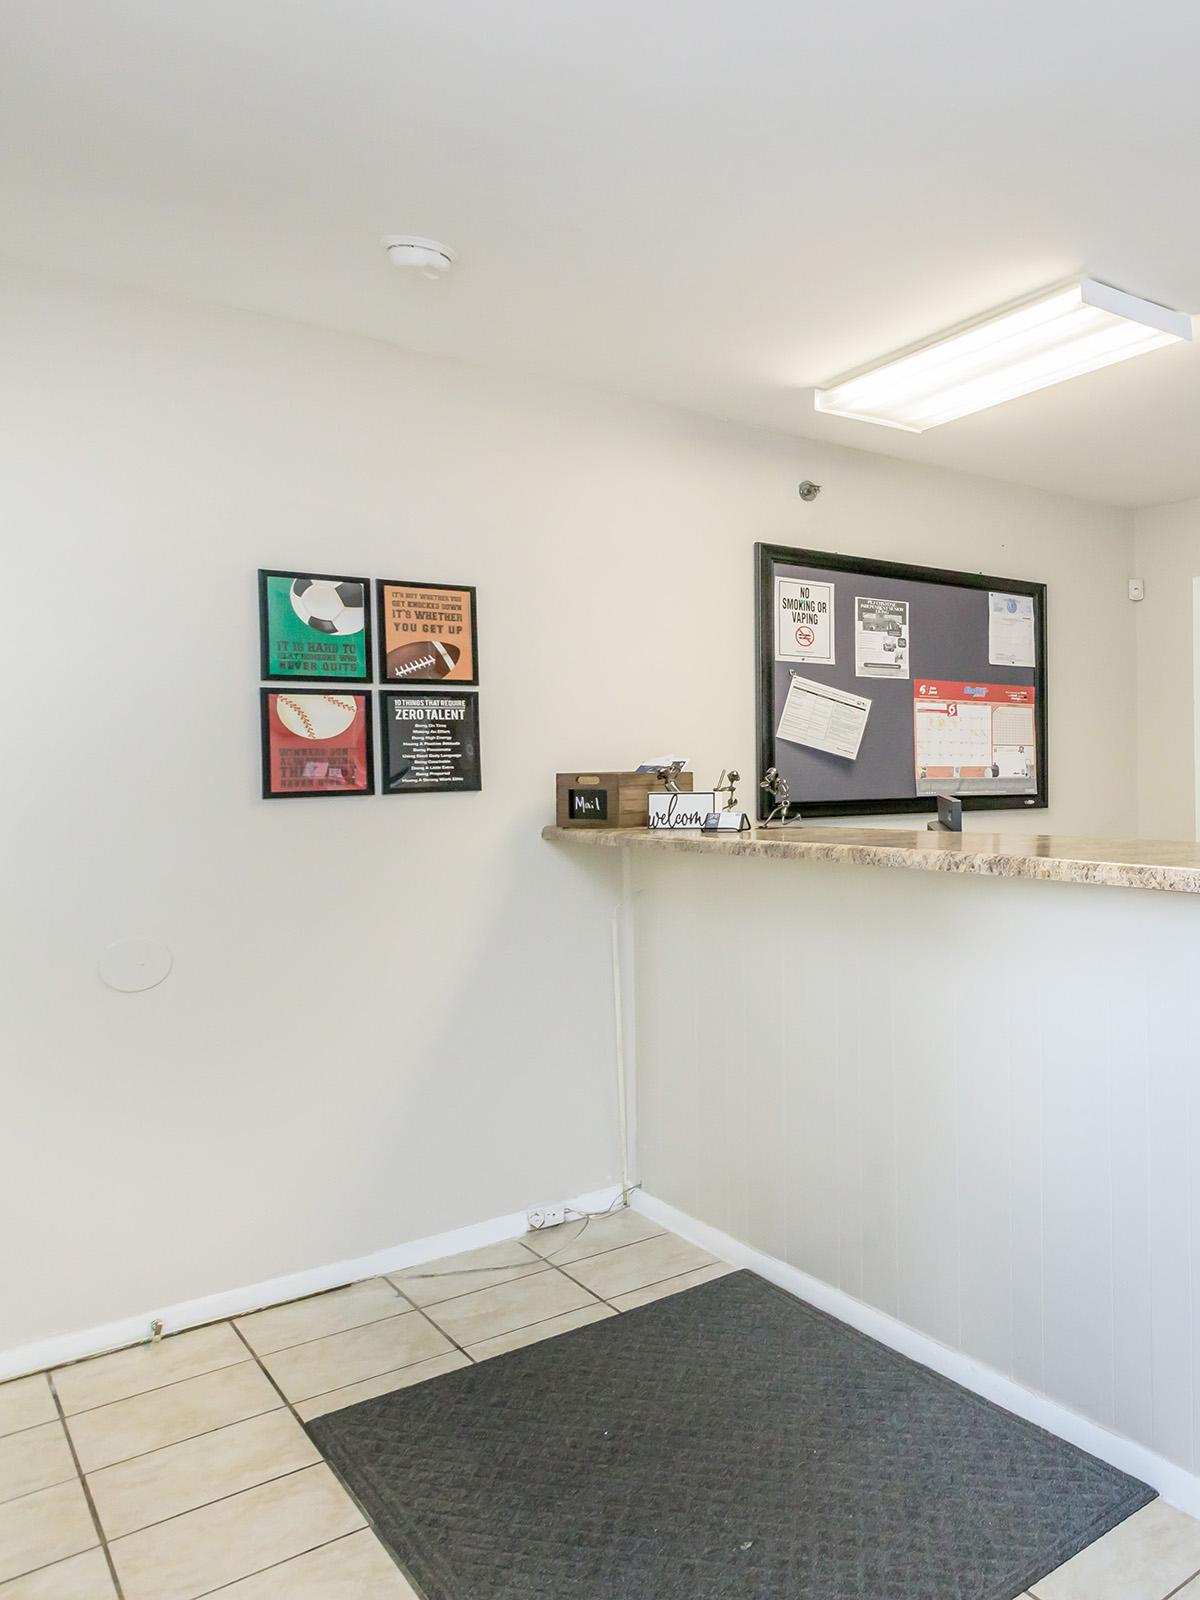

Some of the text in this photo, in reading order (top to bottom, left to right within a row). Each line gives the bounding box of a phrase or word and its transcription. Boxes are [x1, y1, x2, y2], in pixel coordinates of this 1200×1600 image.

[800, 586, 810, 599] NO
[407, 601, 440, 610] KNOCKED
[441, 603, 462, 611] DOWN
[782, 597, 827, 613] SMOKING OR
[392, 609, 463, 622] IT'S WHETHER
[791, 611, 818, 625] VAPING
[393, 622, 463, 634] YOU GET UP
[307, 641, 338, 653] HARD
[342, 644, 356, 654] TO
[279, 661, 357, 672] NEVER QUITS
[919, 685, 926, 695] 6
[395, 709, 465, 720] ZERO TALENT
[575, 796, 600, 813] Mail
[649, 793, 708, 829] welcom
